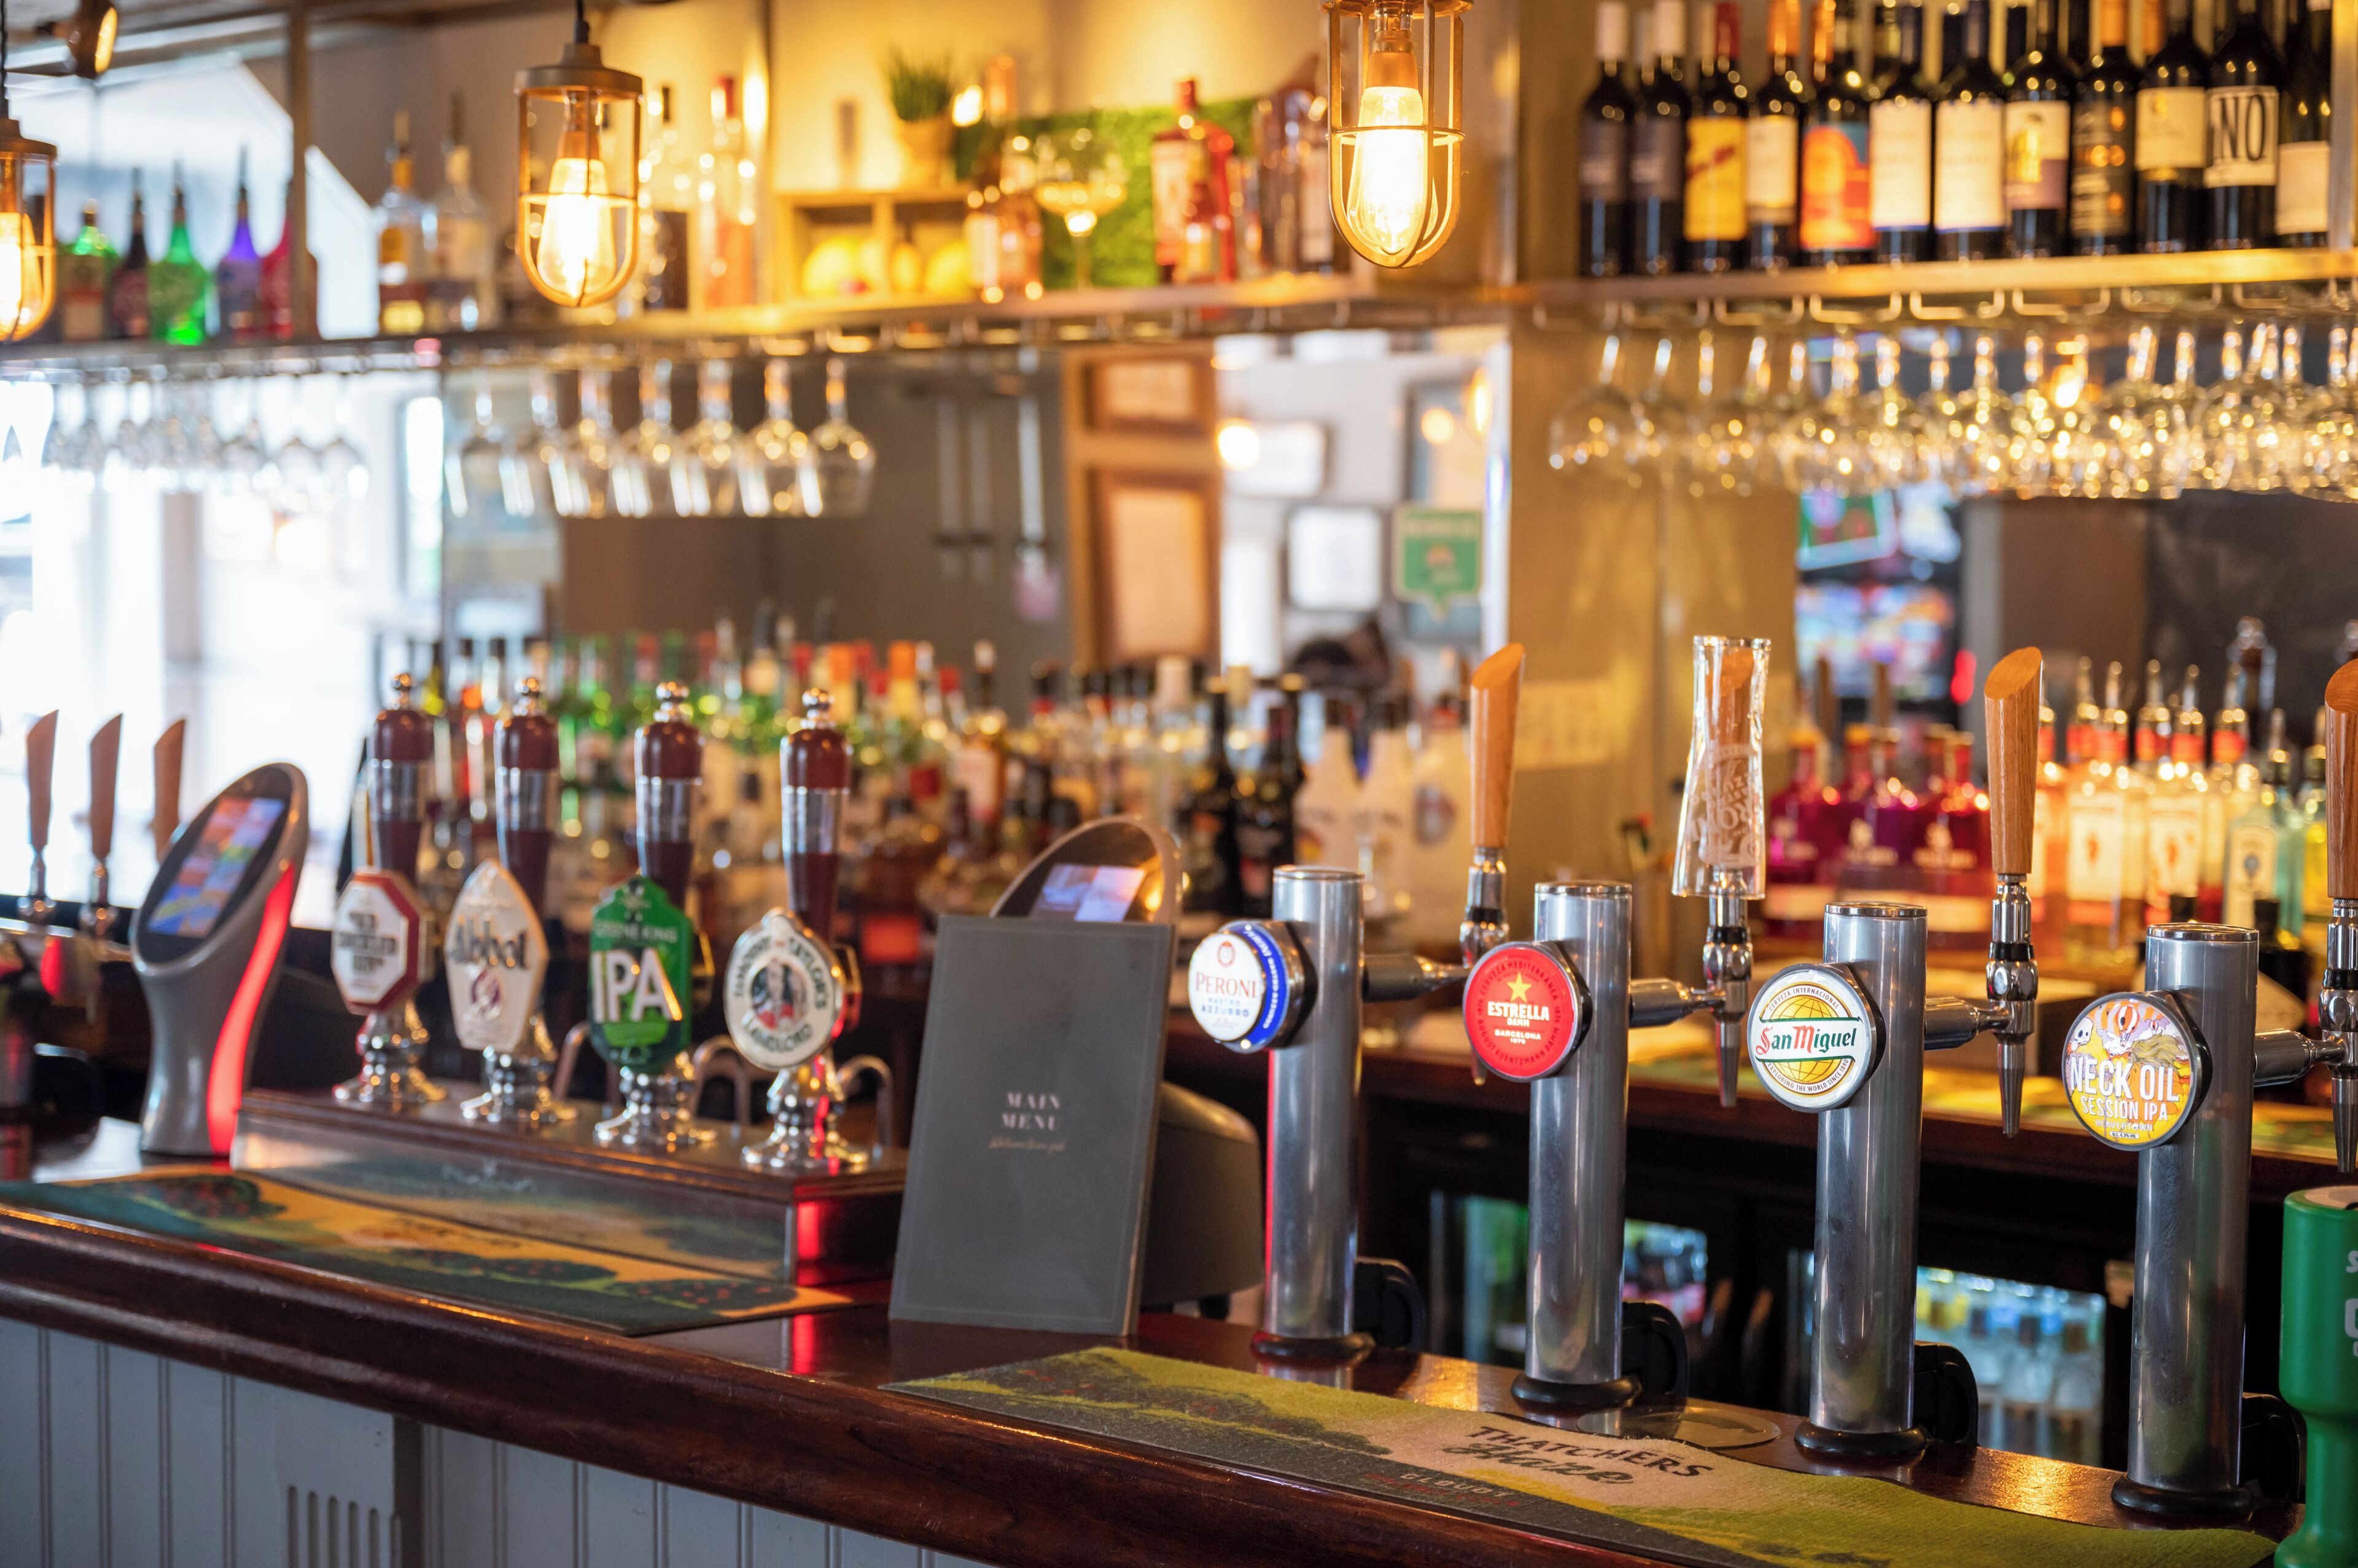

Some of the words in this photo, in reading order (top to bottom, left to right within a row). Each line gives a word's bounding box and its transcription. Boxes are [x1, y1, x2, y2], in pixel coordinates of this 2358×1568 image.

[591, 948, 683, 1023] IPA
[1196, 972, 1258, 999] PERONI
[1201, 1005, 1250, 1017] AZZURRO
[1487, 1001, 1550, 1022] ESTRELLA
[1768, 990, 1791, 1012] CERVEZA
[1793, 987, 1840, 1010] INTERNACIONAL
[1494, 1028, 1542, 1041] BARCELONA
[1507, 1017, 1530, 1027] DAMM
[1756, 1025, 1792, 1055] San
[1792, 1025, 1857, 1054] Miguel
[1767, 1062, 1794, 1089] EXPLORING
[1807, 1083, 1827, 1092] WORLD
[1827, 1071, 1841, 1086] SINCE
[1840, 1059, 1849, 1073] 1890
[2070, 1055, 2133, 1100] NECK
[2139, 1065, 2180, 1103] OIL
[1006, 1091, 1061, 1110] MAIN
[2080, 1095, 2139, 1121] SESSION
[2143, 1101, 2169, 1122] IPA
[1002, 1112, 1060, 1131] MENU
[2095, 1119, 2154, 1132] BEAVERTOWN
[1466, 1426, 1714, 1478] THATCHERS
